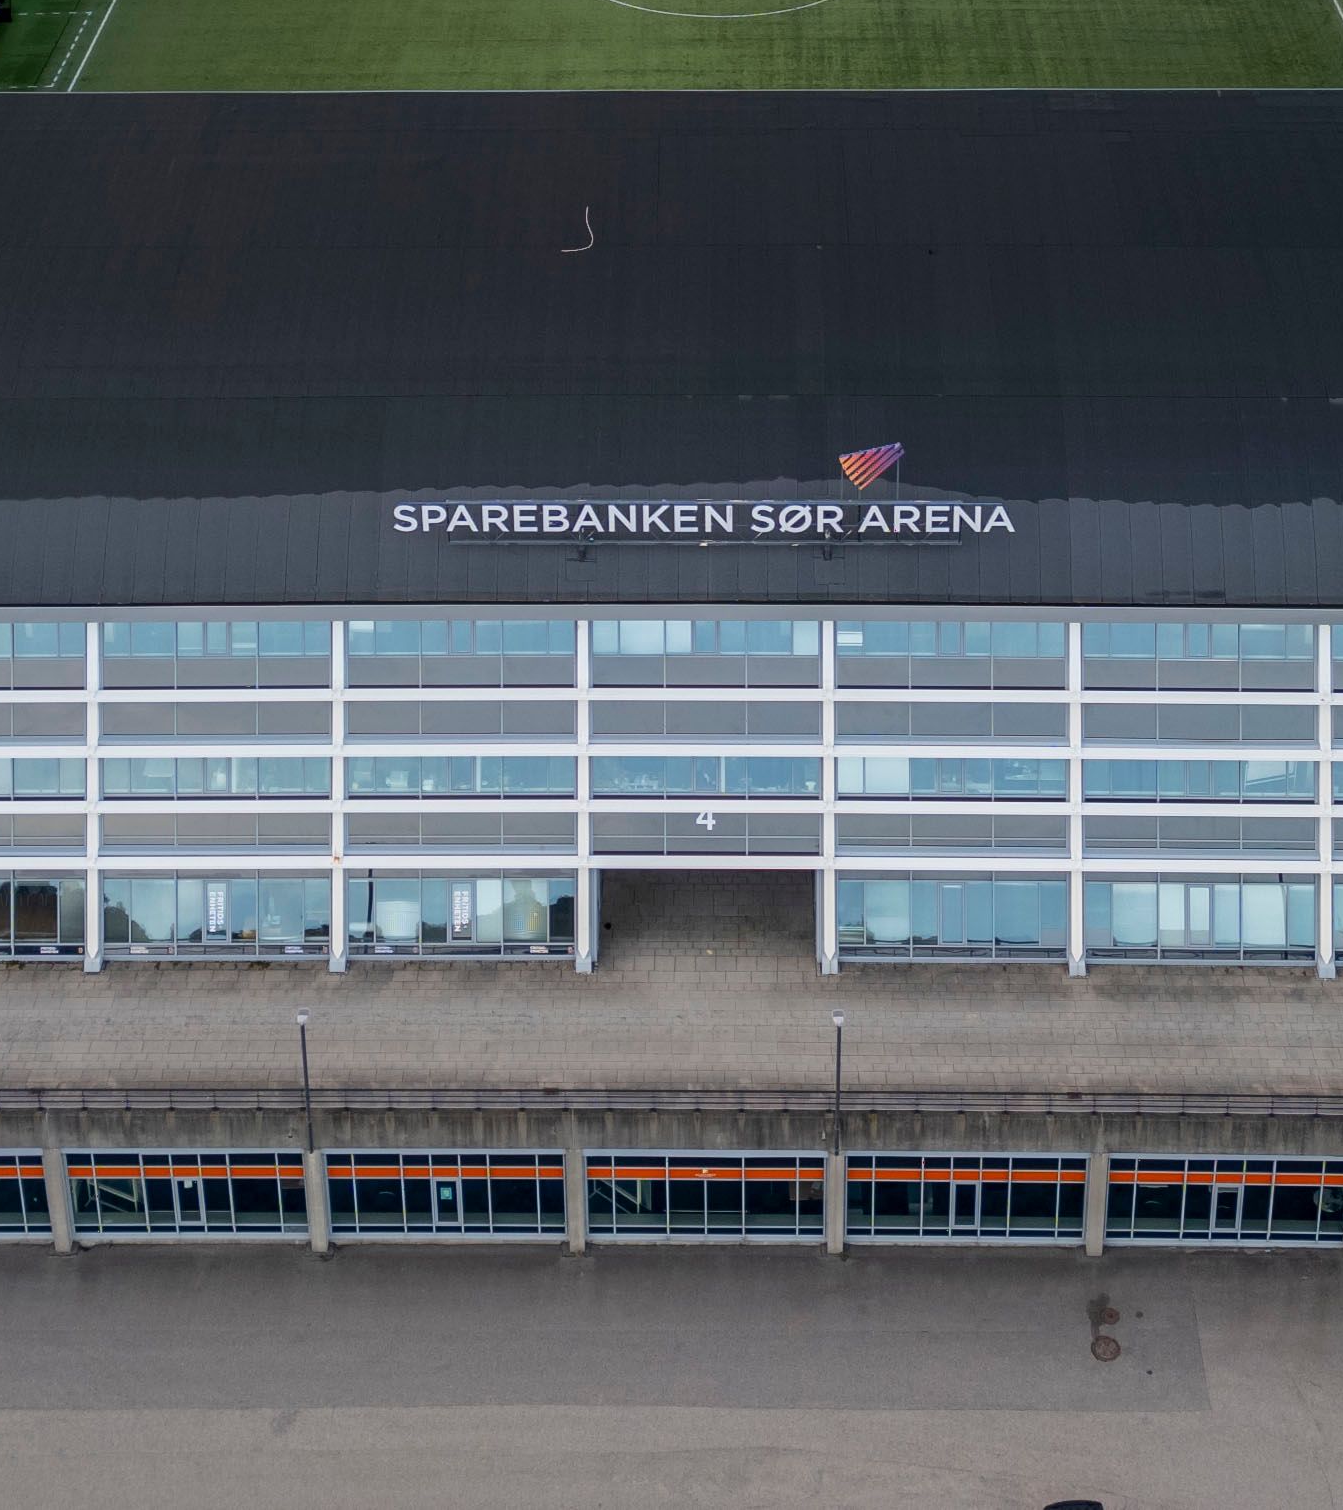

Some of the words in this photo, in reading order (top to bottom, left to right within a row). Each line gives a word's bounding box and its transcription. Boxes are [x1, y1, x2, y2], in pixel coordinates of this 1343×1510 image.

[393, 504, 734, 533] SPAREBANKEN
[750, 502, 845, 534] SØR
[859, 504, 1015, 533] ARENA
[695, 810, 716, 831] 4
